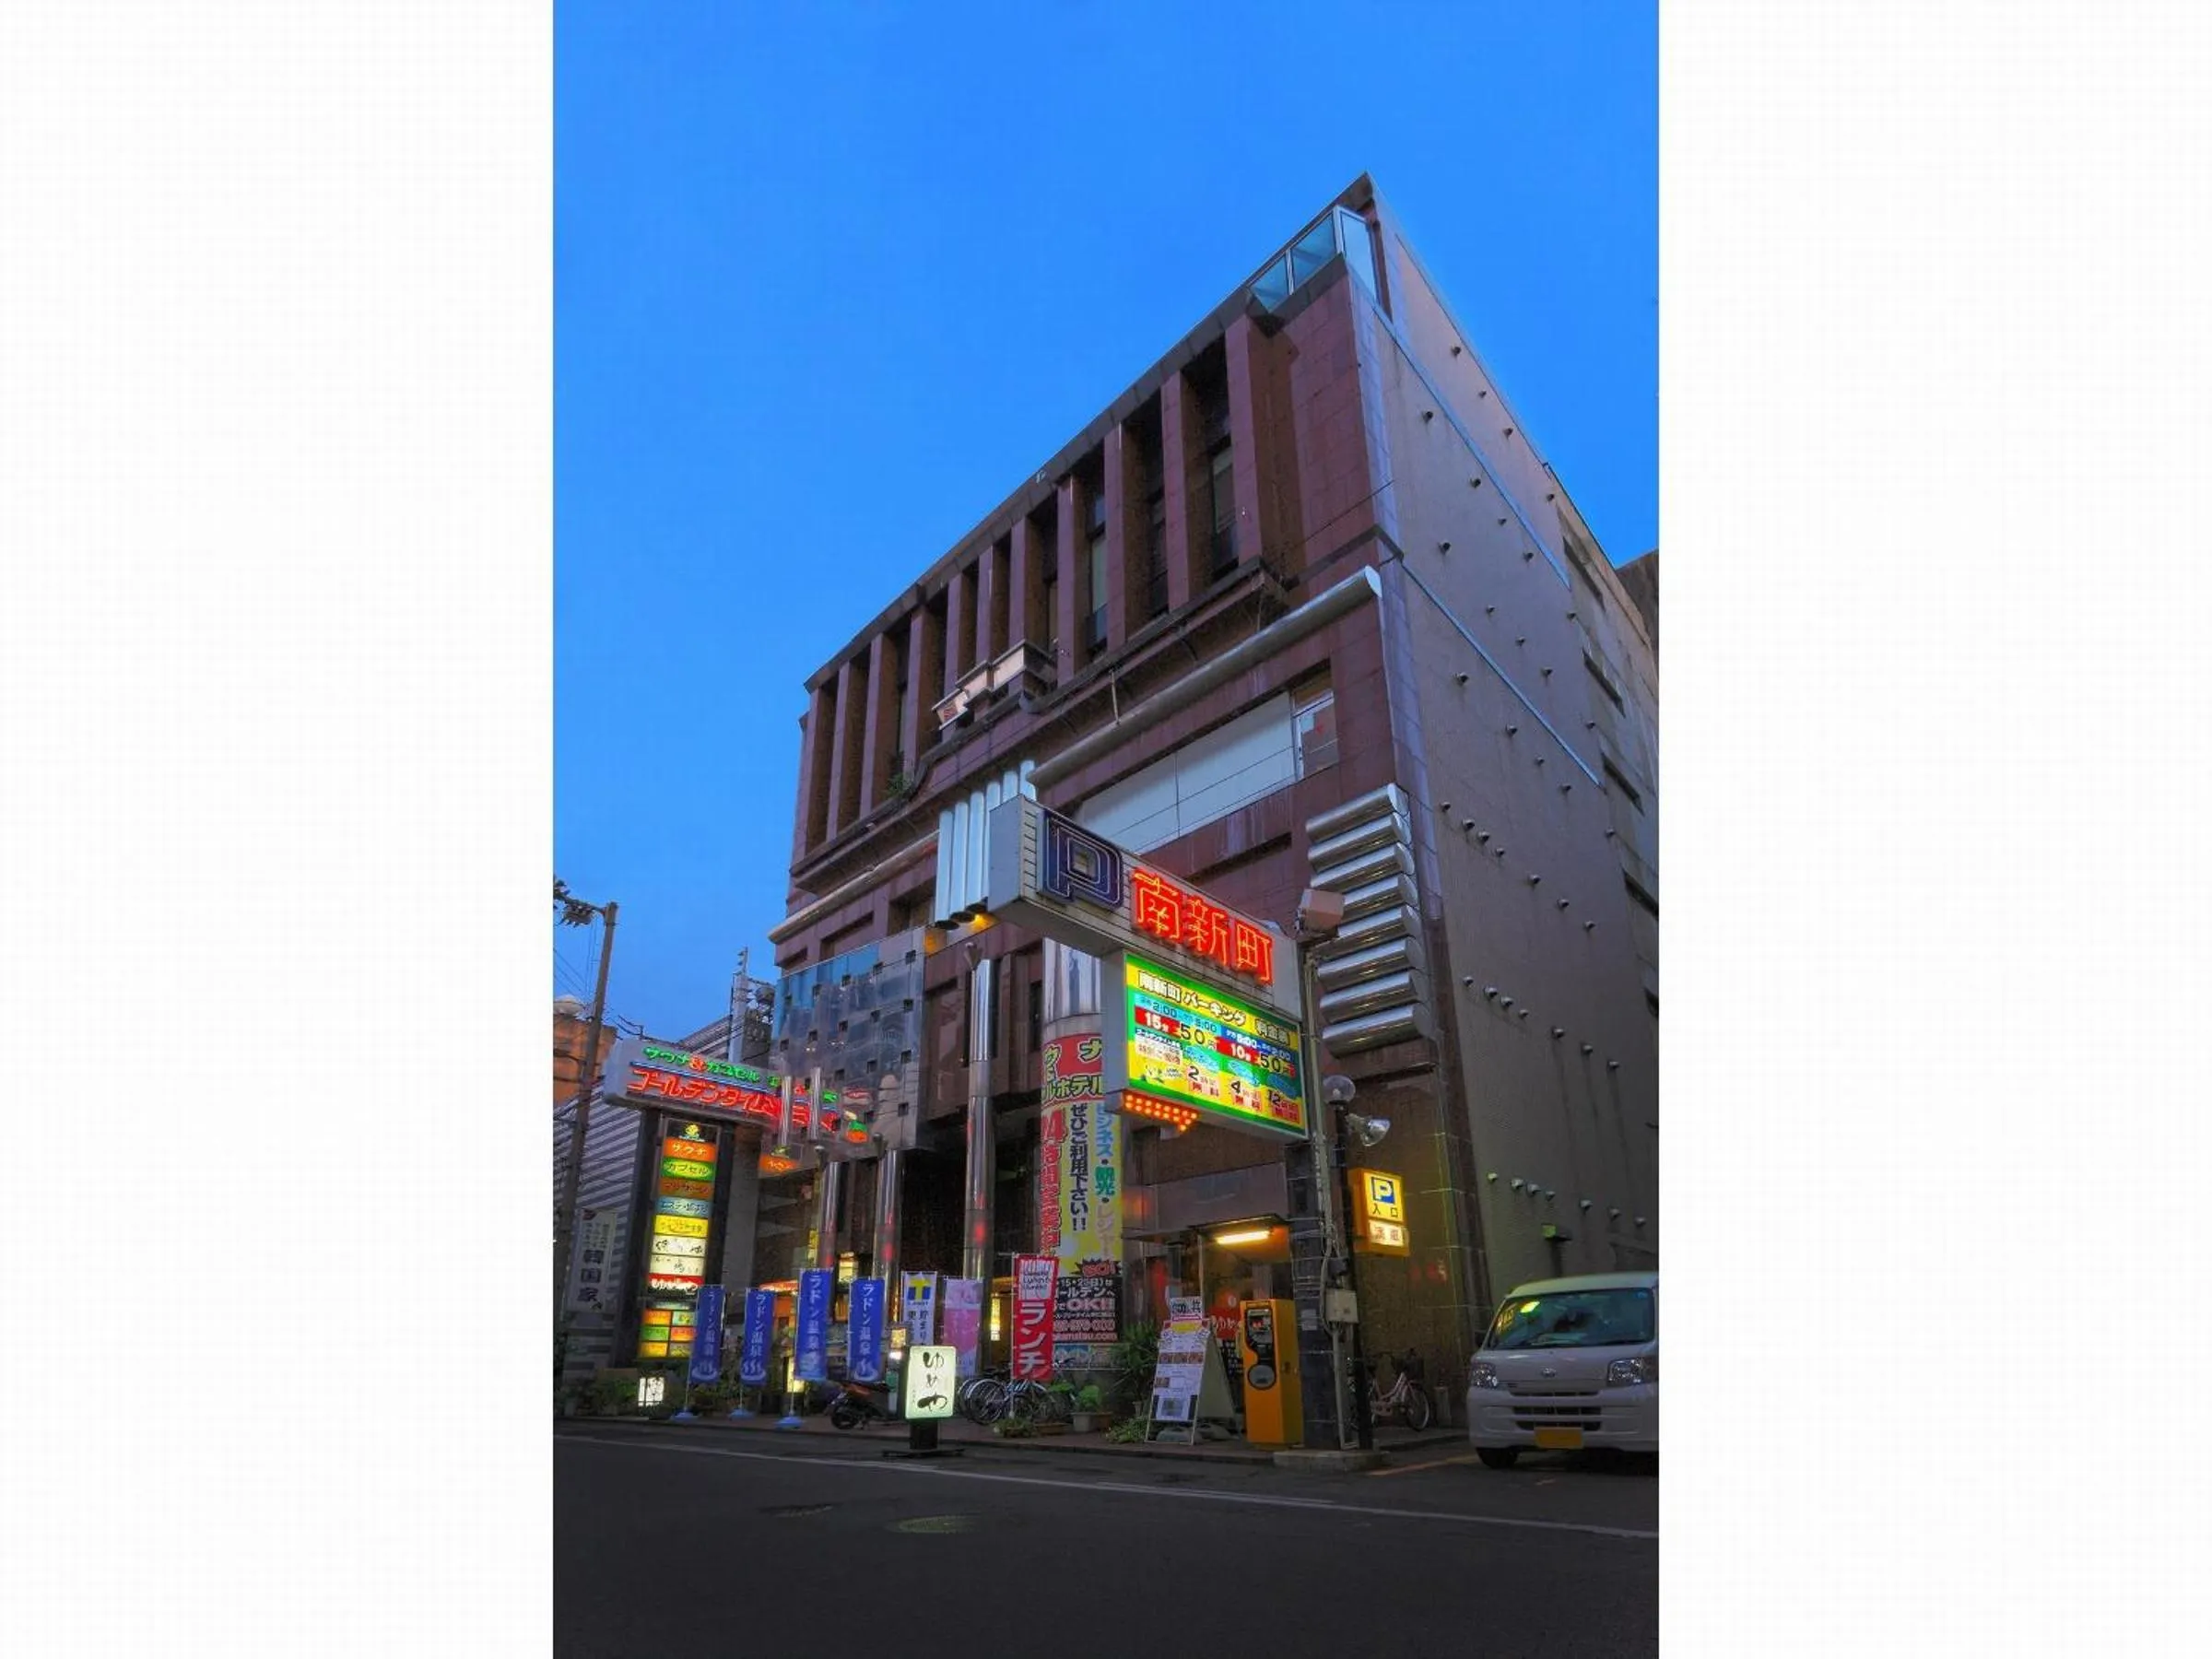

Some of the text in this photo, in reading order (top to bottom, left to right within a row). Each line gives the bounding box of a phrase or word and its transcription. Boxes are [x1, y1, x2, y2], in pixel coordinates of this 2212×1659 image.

[1131, 867, 1274, 986] 南新町
[1182, 991, 1247, 1027] パーキング
[1372, 1203, 1399, 1218] 入口
[859, 1283, 875, 1355] ラドン温泉
[1018, 1301, 1047, 1376] ランチ
